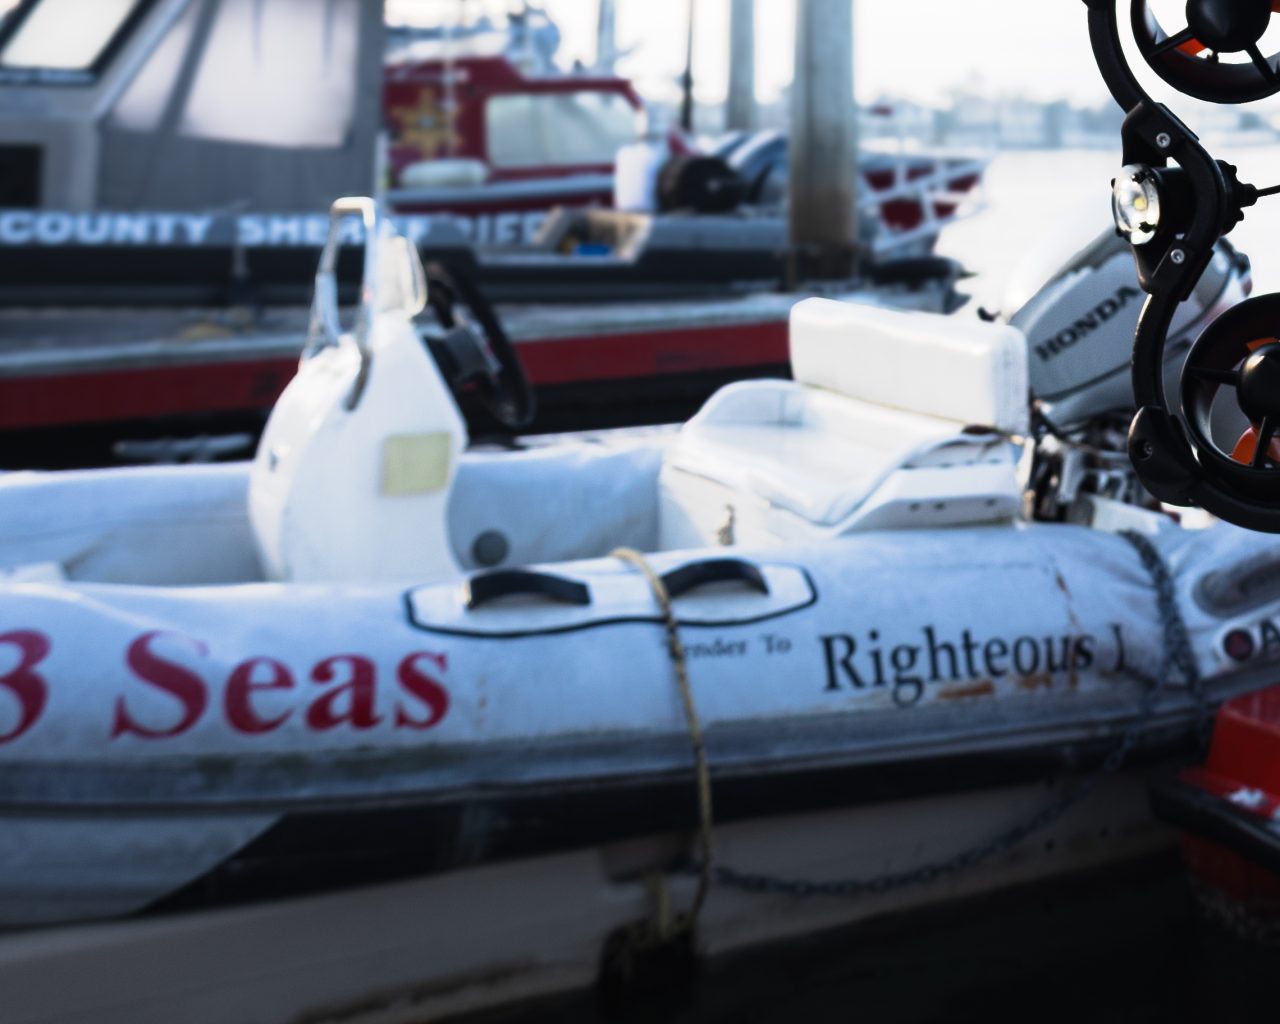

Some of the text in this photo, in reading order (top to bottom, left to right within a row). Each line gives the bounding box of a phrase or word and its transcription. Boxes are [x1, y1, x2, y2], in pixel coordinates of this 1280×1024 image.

[0, 210, 212, 244] COUNTY
[1033, 285, 1141, 362] HONDA
[109, 629, 452, 742] Seas
[761, 632, 794, 656] To
[819, 624, 1095, 707] Righteous
